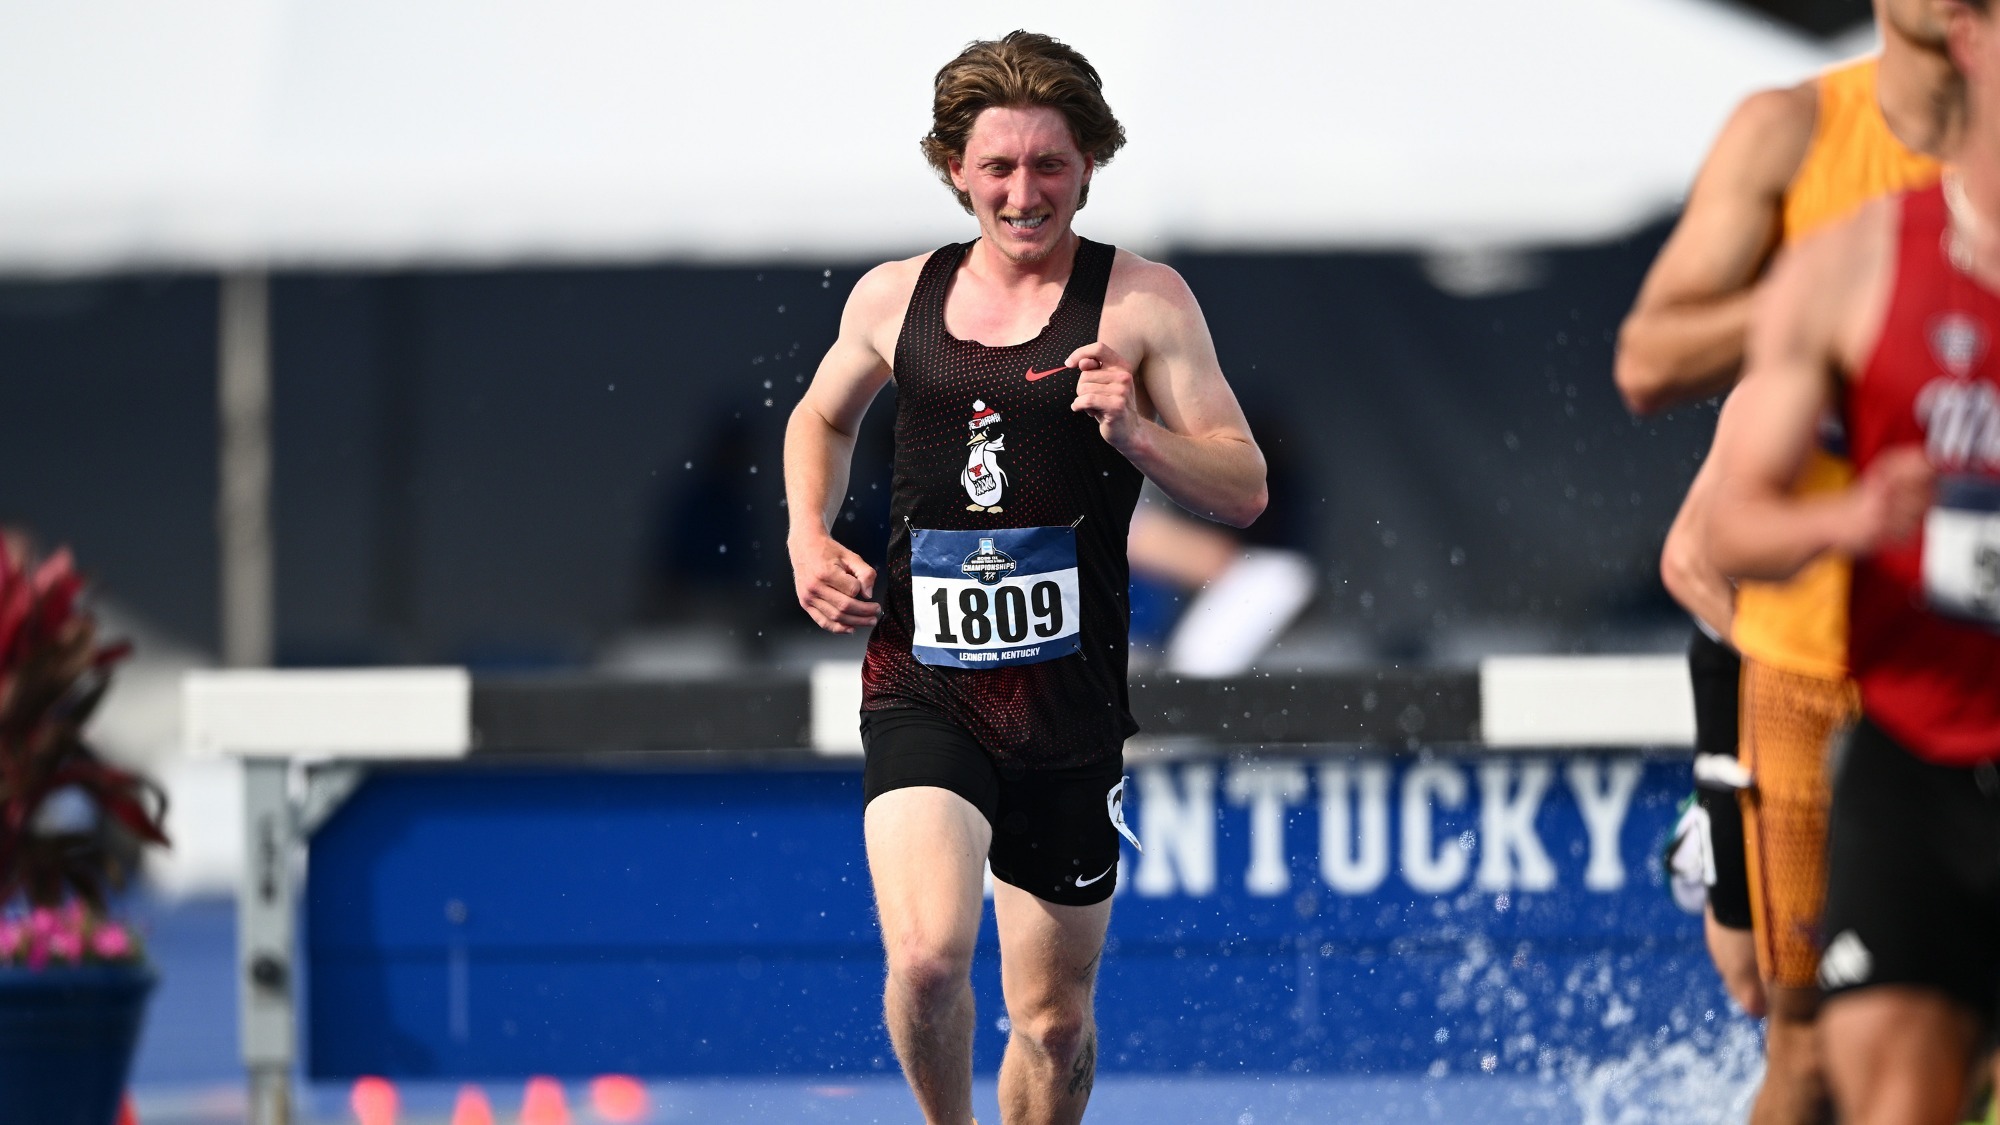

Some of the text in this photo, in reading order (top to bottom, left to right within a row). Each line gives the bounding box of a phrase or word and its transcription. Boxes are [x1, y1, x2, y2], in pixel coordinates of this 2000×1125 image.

[963, 562, 1015, 572] CHAMPIONSHIPS
[931, 580, 1064, 646] 1809
[959, 646, 1041, 662] LEXINGTON, KENTUCKY
[983, 758, 1643, 896] NTUCKY
